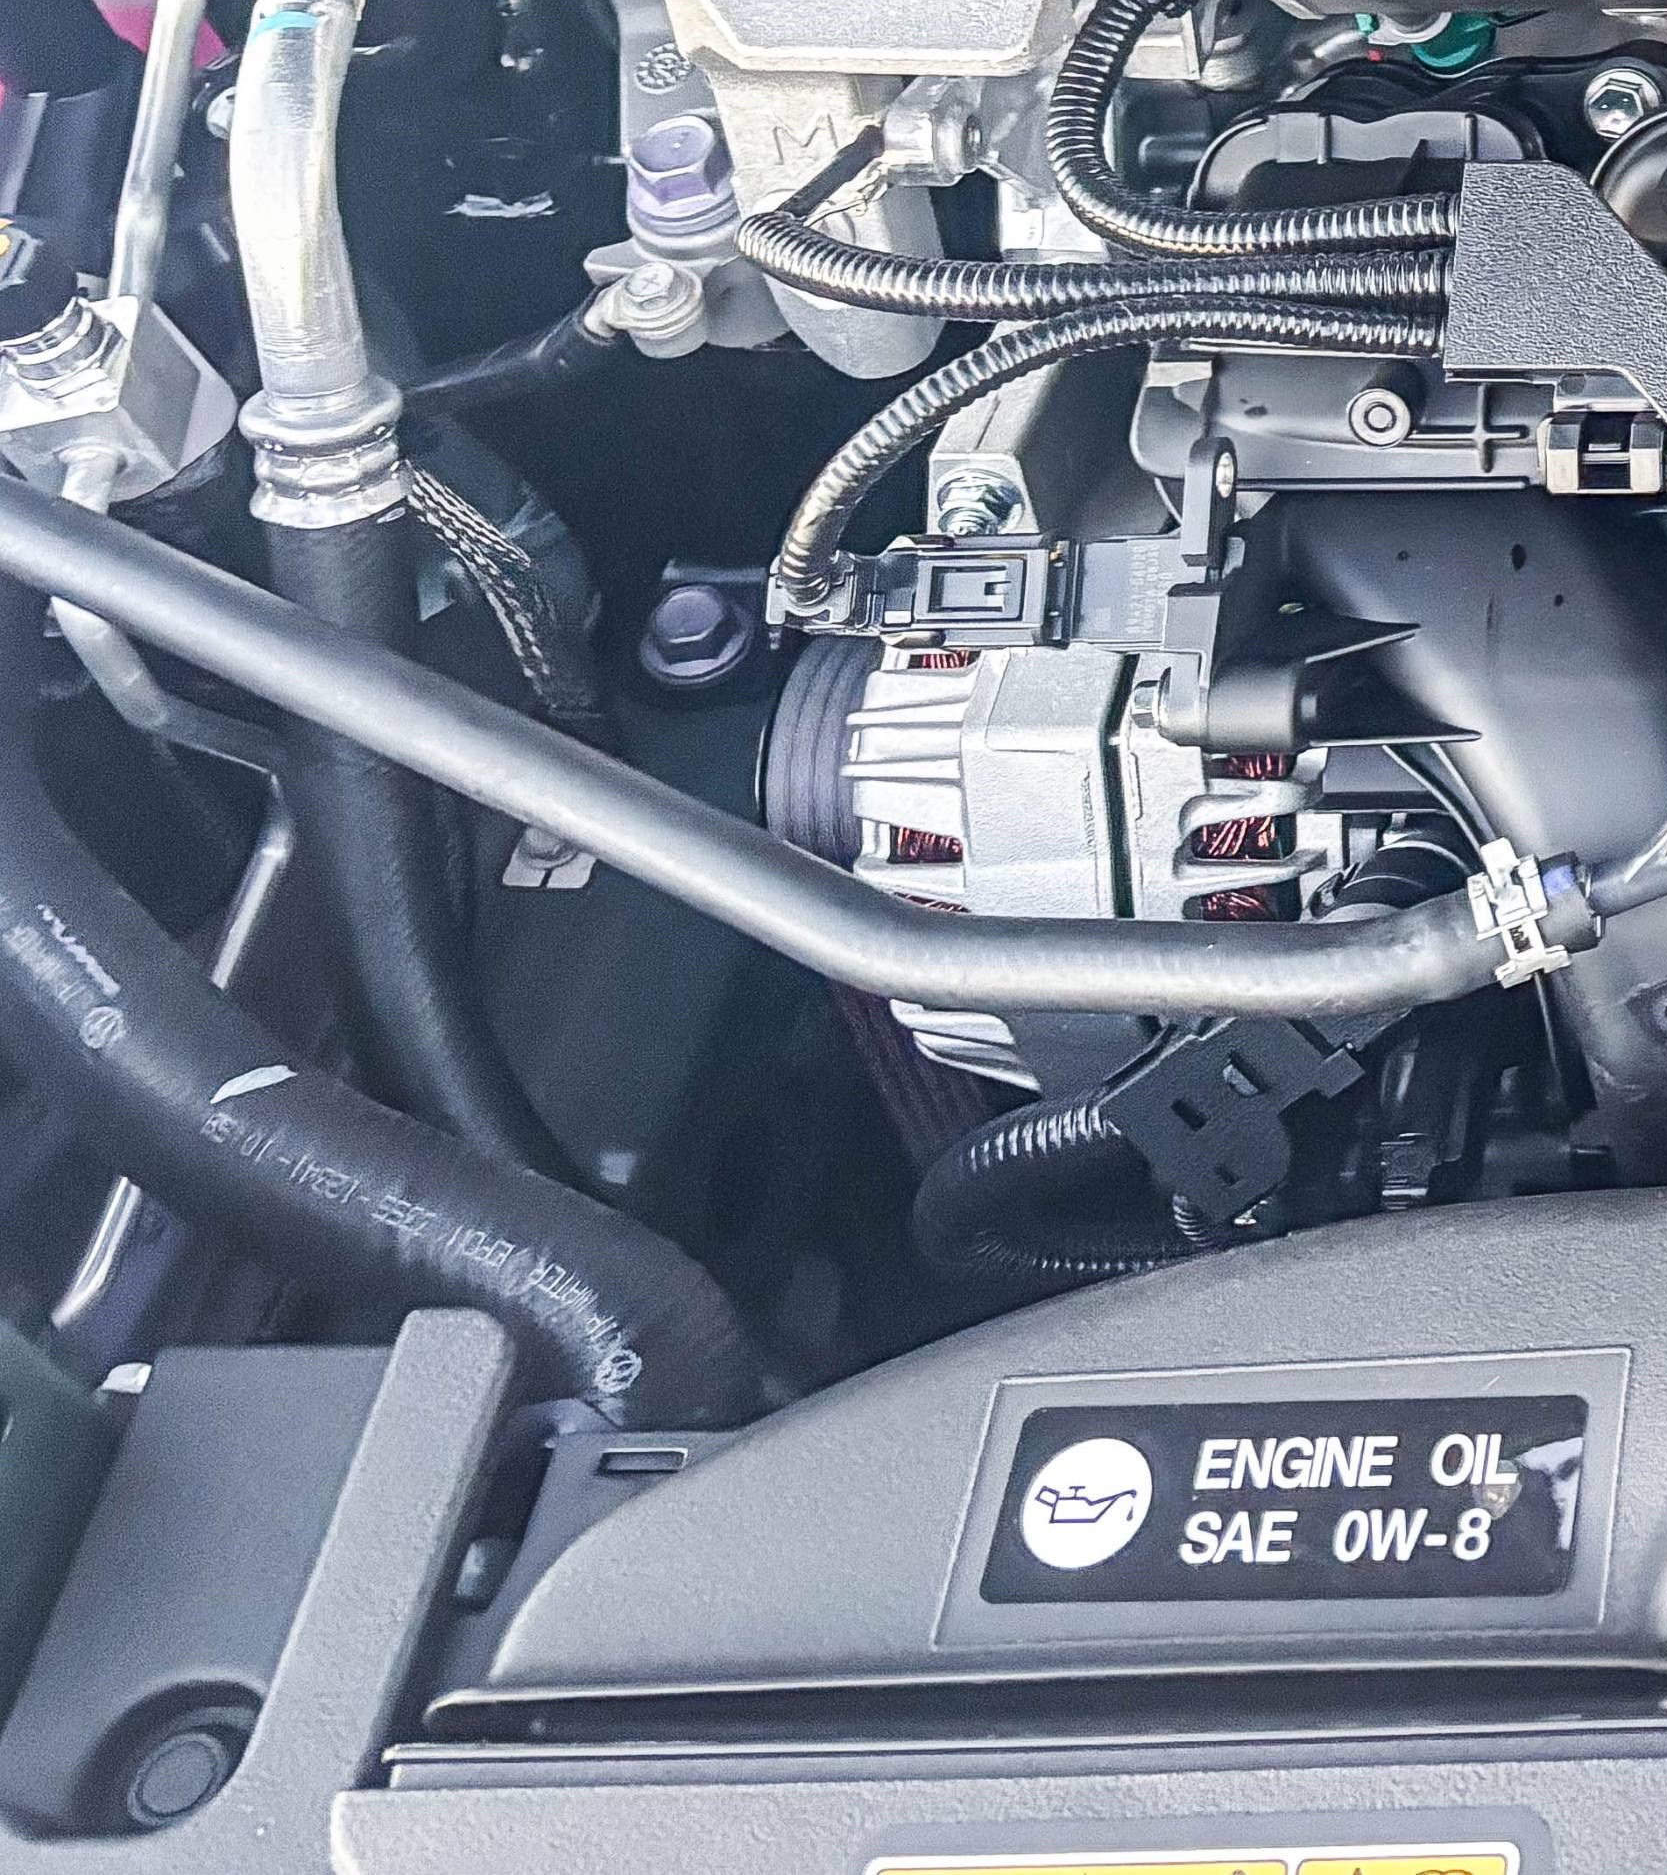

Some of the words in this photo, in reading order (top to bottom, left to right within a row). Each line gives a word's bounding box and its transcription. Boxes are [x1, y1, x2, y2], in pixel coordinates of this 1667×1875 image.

[1192, 1435, 1399, 1491] ENGINE
[1430, 1433, 1519, 1487] OIL
[1179, 1510, 1299, 1565] SAE
[1332, 1507, 1492, 1564] 0W-8
